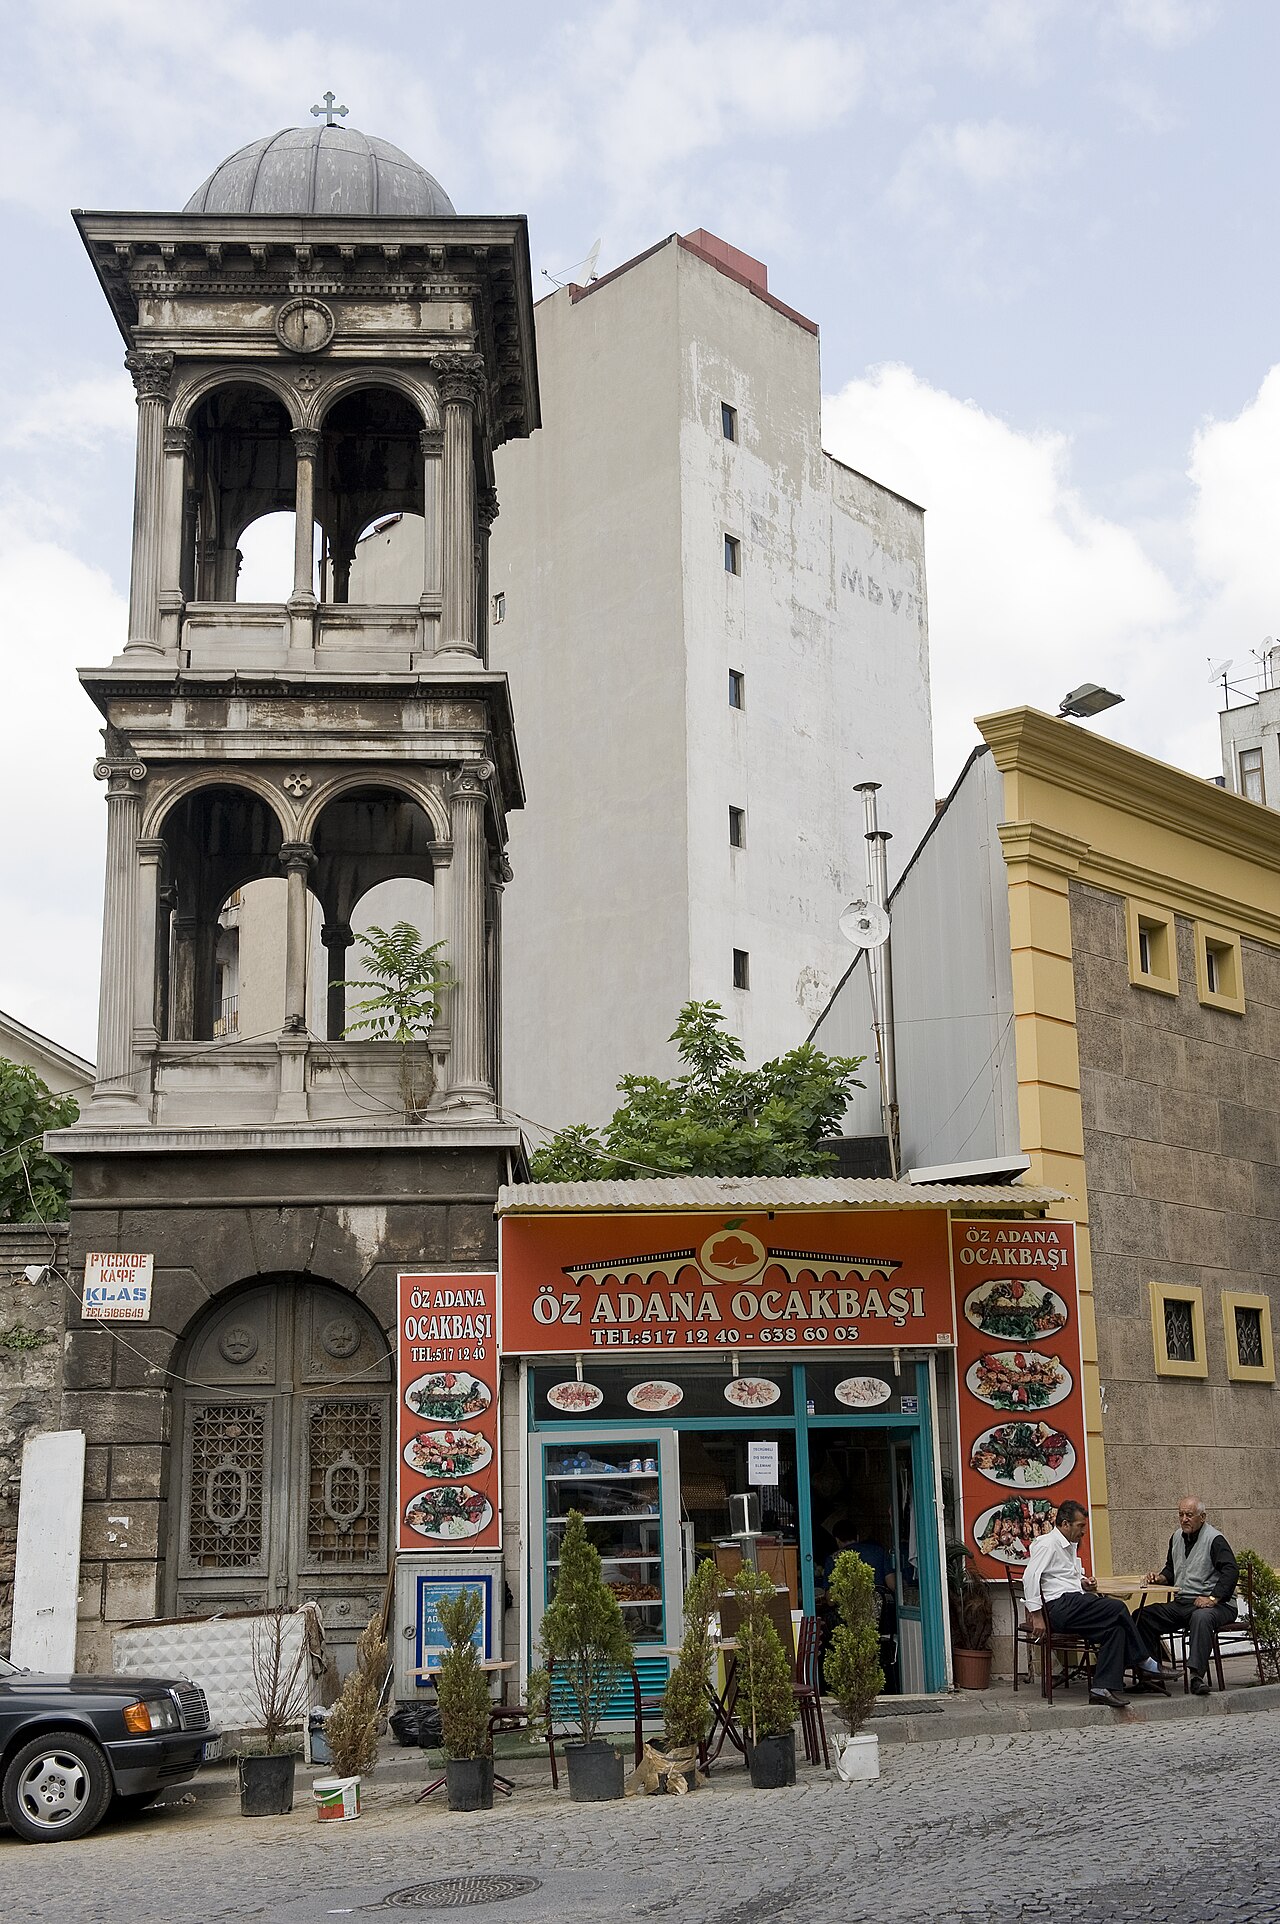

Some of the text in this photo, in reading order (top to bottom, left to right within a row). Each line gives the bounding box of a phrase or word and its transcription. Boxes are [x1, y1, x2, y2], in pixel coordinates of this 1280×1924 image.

[966, 1226, 1060, 1244] ÖZ ADANA
[91, 1254, 147, 1268] РУССКОЕ
[960, 1247, 1068, 1271] OCAKBAŞI
[100, 1270, 136, 1283] КАФЕ
[86, 1288, 147, 1301] KLAS
[410, 1286, 486, 1309] ÖZ ADANA
[532, 1285, 926, 1327] ÖZ ADANA OCAKBAŞI
[404, 1314, 492, 1346] OCAKBAŞI
[685, 1329, 709, 1344] 12
[715, 1328, 740, 1344] 40
[759, 1327, 797, 1342] 638
[803, 1326, 829, 1342] 60
[834, 1325, 860, 1341] 03
[458, 1347, 470, 1361] 12
[472, 1346, 486, 1360] 40
